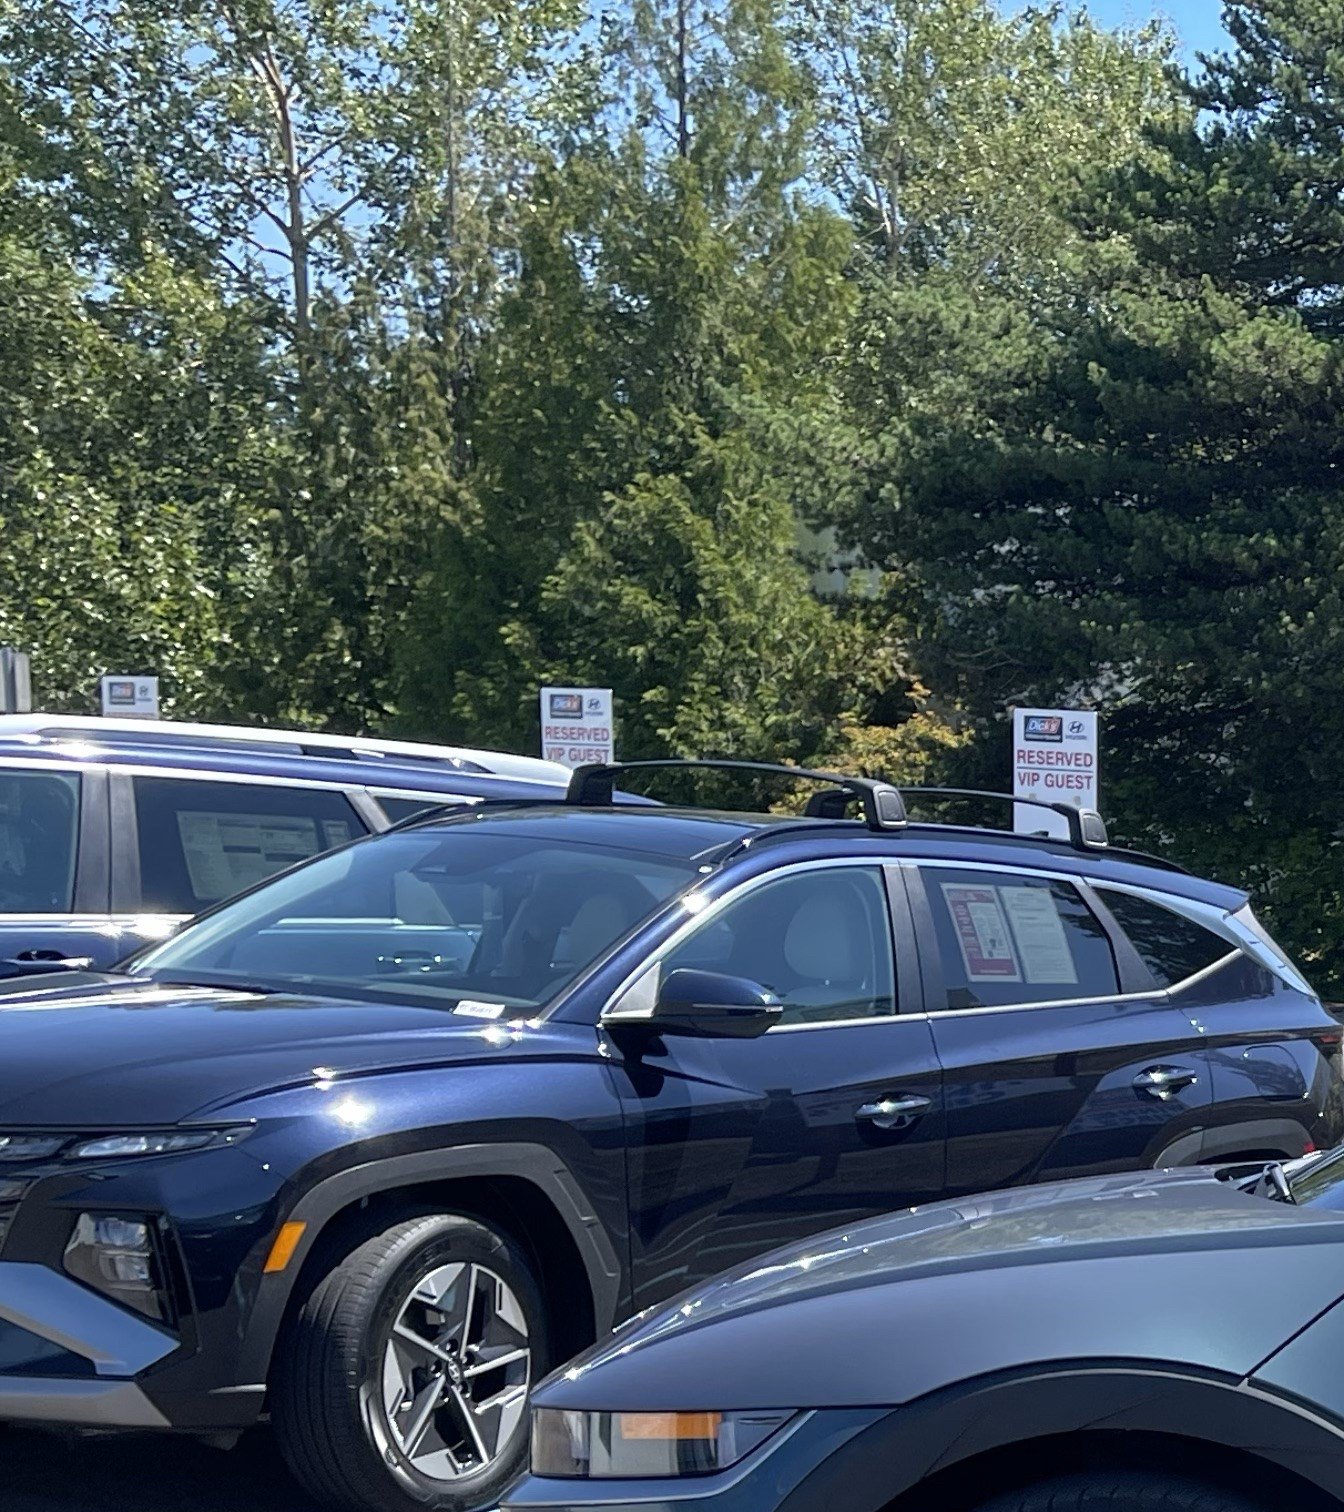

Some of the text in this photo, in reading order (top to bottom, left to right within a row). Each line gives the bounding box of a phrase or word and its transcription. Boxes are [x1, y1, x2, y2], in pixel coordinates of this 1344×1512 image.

[545, 726, 609, 741] RESERVED
[545, 747, 610, 764] VIP GUEST
[1016, 749, 1093, 767] RESERVED
[1017, 771, 1093, 790] VIP GUEST
